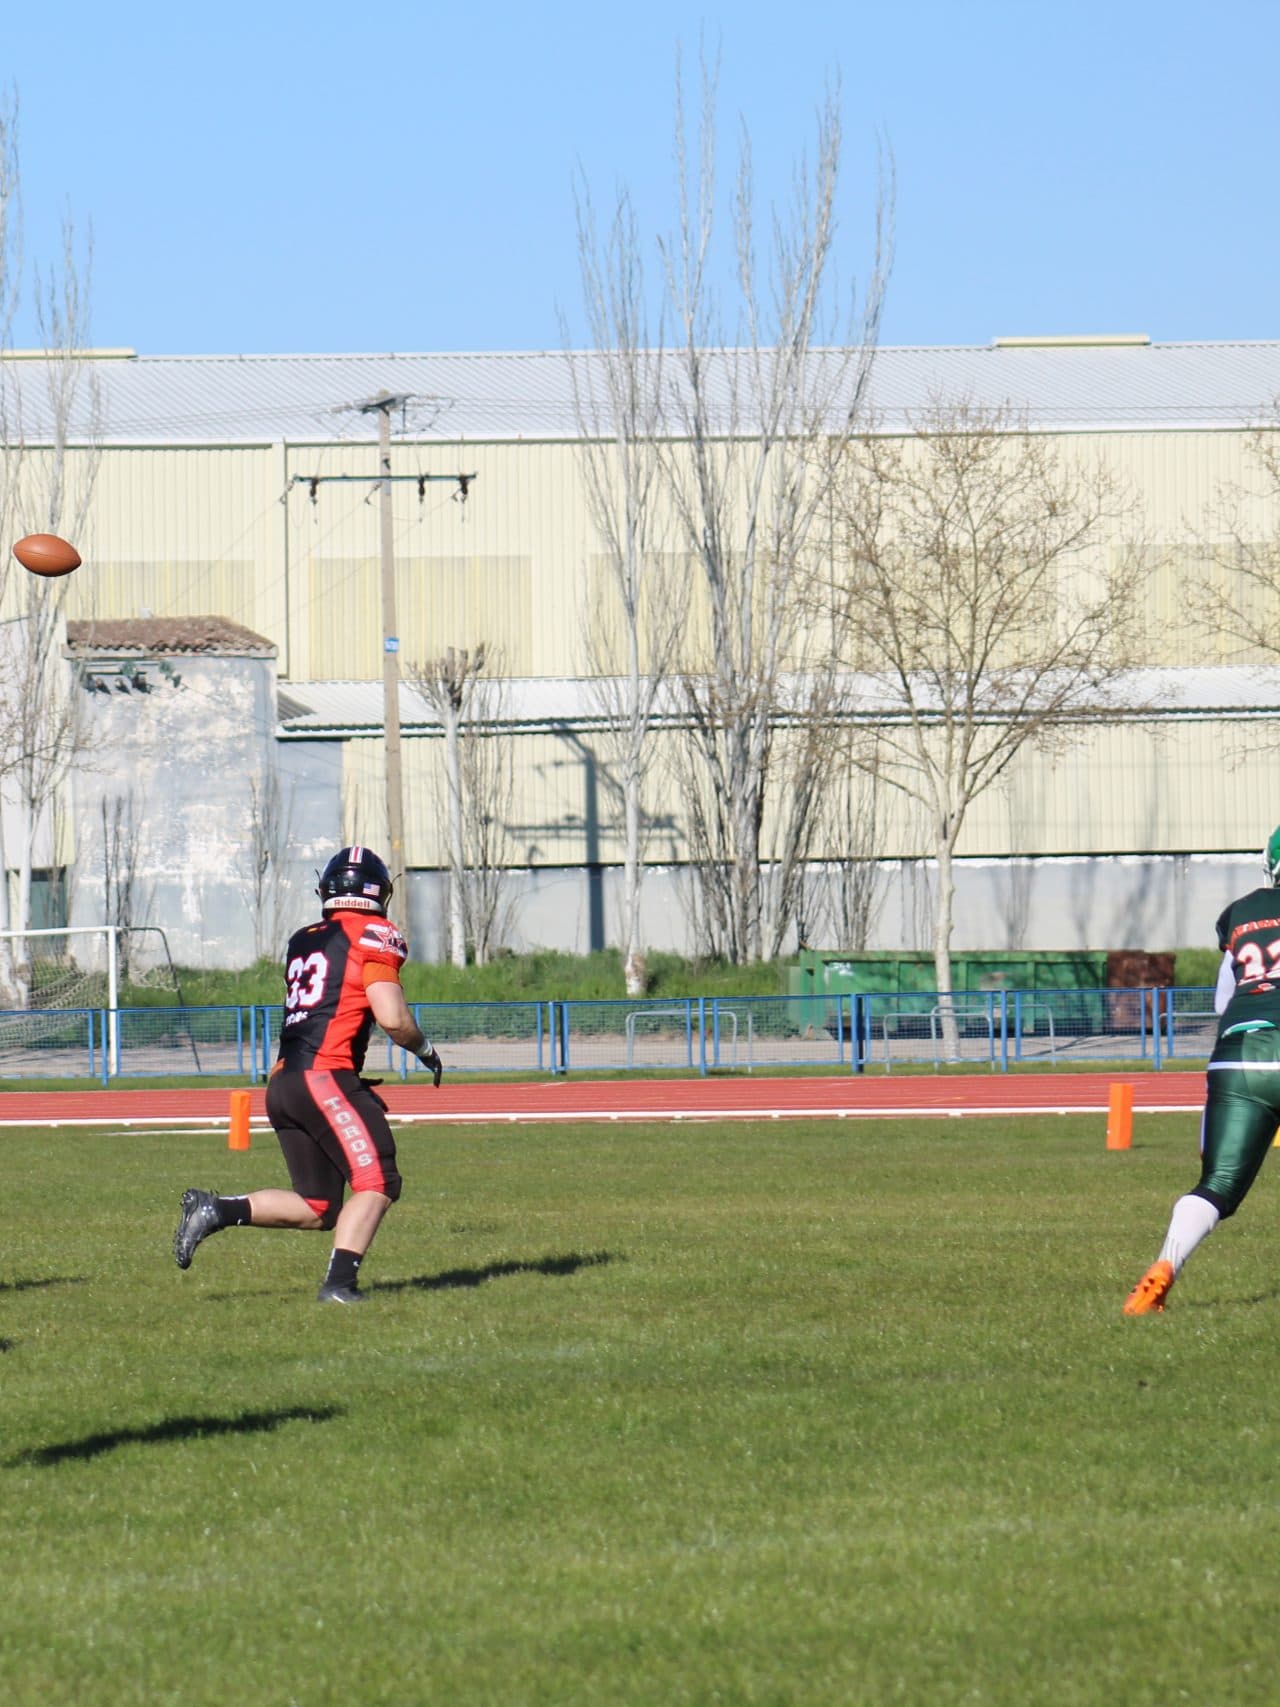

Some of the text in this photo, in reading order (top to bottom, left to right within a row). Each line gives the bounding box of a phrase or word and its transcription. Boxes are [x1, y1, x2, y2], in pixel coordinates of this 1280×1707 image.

[334, 899, 370, 909] Riddell
[286, 950, 328, 1009] 33
[323, 1096, 373, 1168] TOROS
